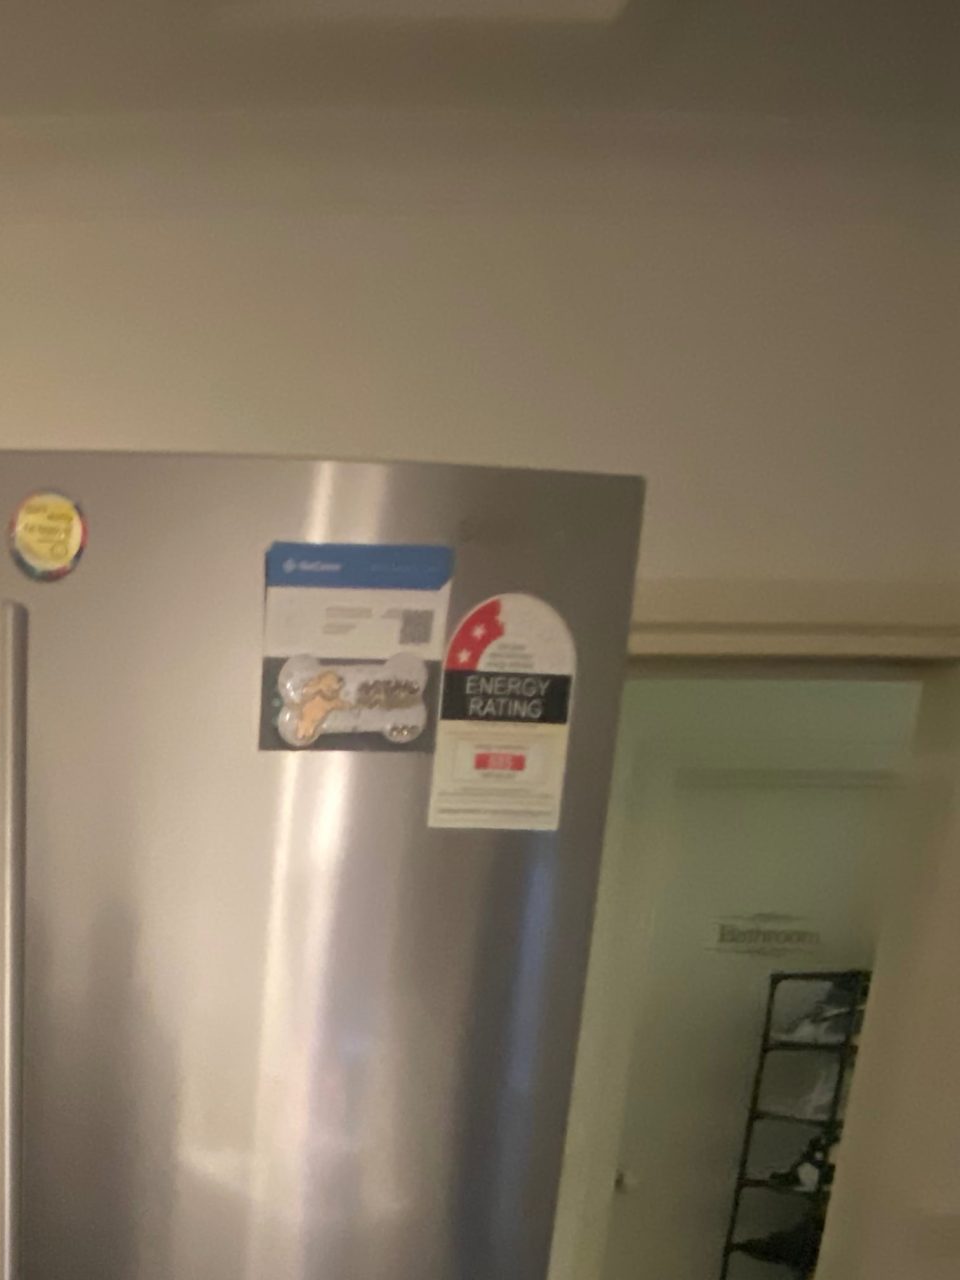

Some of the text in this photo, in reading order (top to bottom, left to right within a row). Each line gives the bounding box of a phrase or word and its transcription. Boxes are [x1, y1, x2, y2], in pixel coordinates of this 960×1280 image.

[465, 674, 551, 697] ENERGY
[467, 696, 544, 719] RATING
[717, 923, 822, 944] Bathroom
